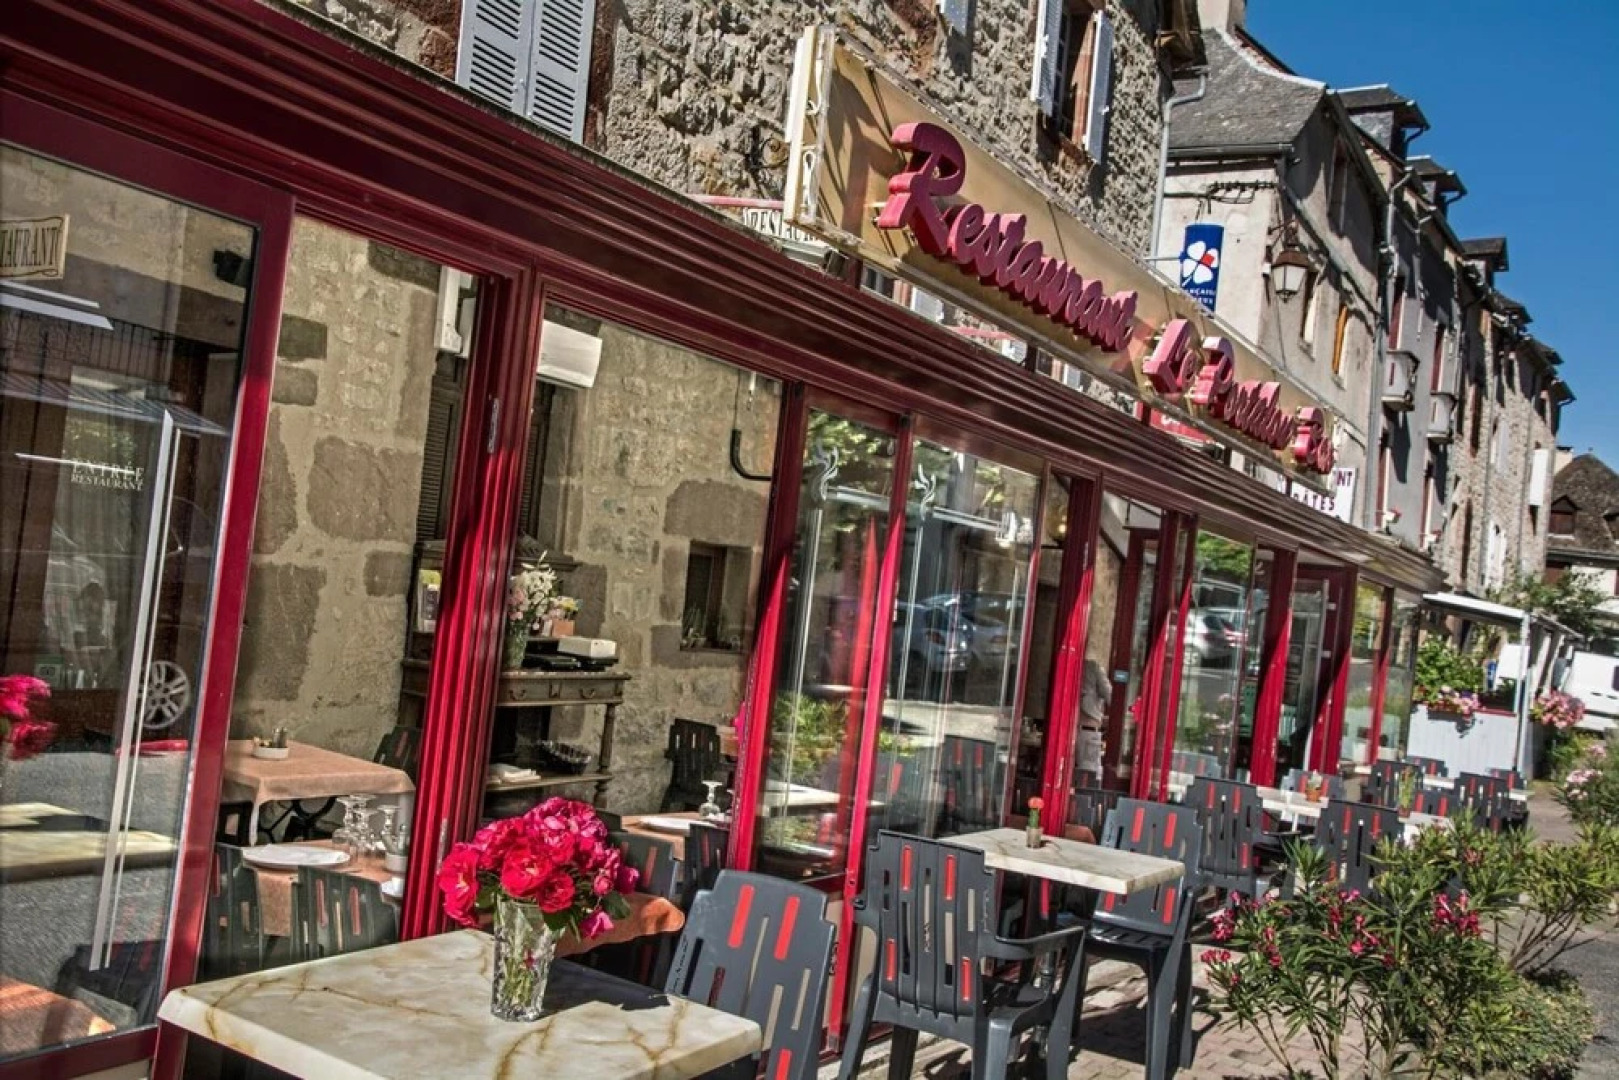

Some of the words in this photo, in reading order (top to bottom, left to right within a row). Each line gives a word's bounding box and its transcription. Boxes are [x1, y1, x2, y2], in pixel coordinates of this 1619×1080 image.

[0, 227, 58, 268] TAURANT
[878, 122, 1138, 351] Restaurant
[71, 474, 143, 491] RESTAURANT
